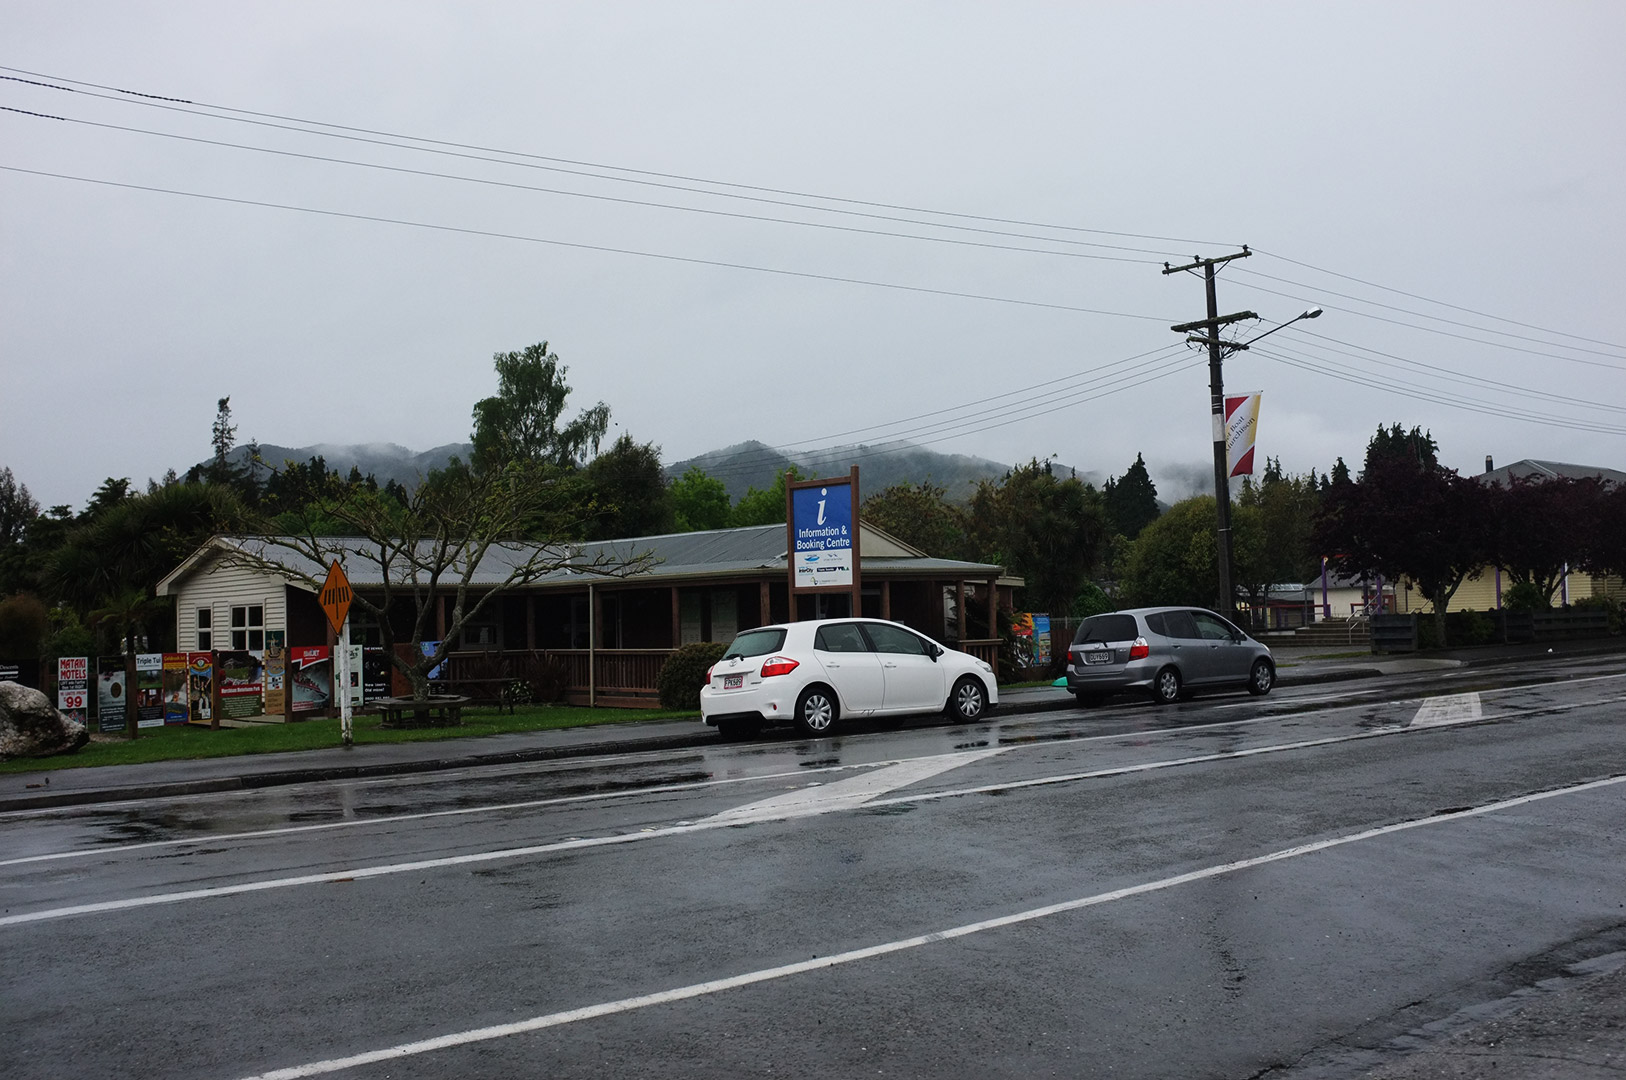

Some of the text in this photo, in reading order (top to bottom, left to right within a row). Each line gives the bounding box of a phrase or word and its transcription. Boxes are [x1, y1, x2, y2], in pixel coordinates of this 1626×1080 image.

[1230, 416, 1245, 432] Boat
[799, 525, 848, 538] Information &
[797, 538, 850, 550] Booking Centre
[60, 659, 86, 670] MATAKI
[136, 658, 152, 666] Triple
[60, 669, 87, 680] MOTELS
